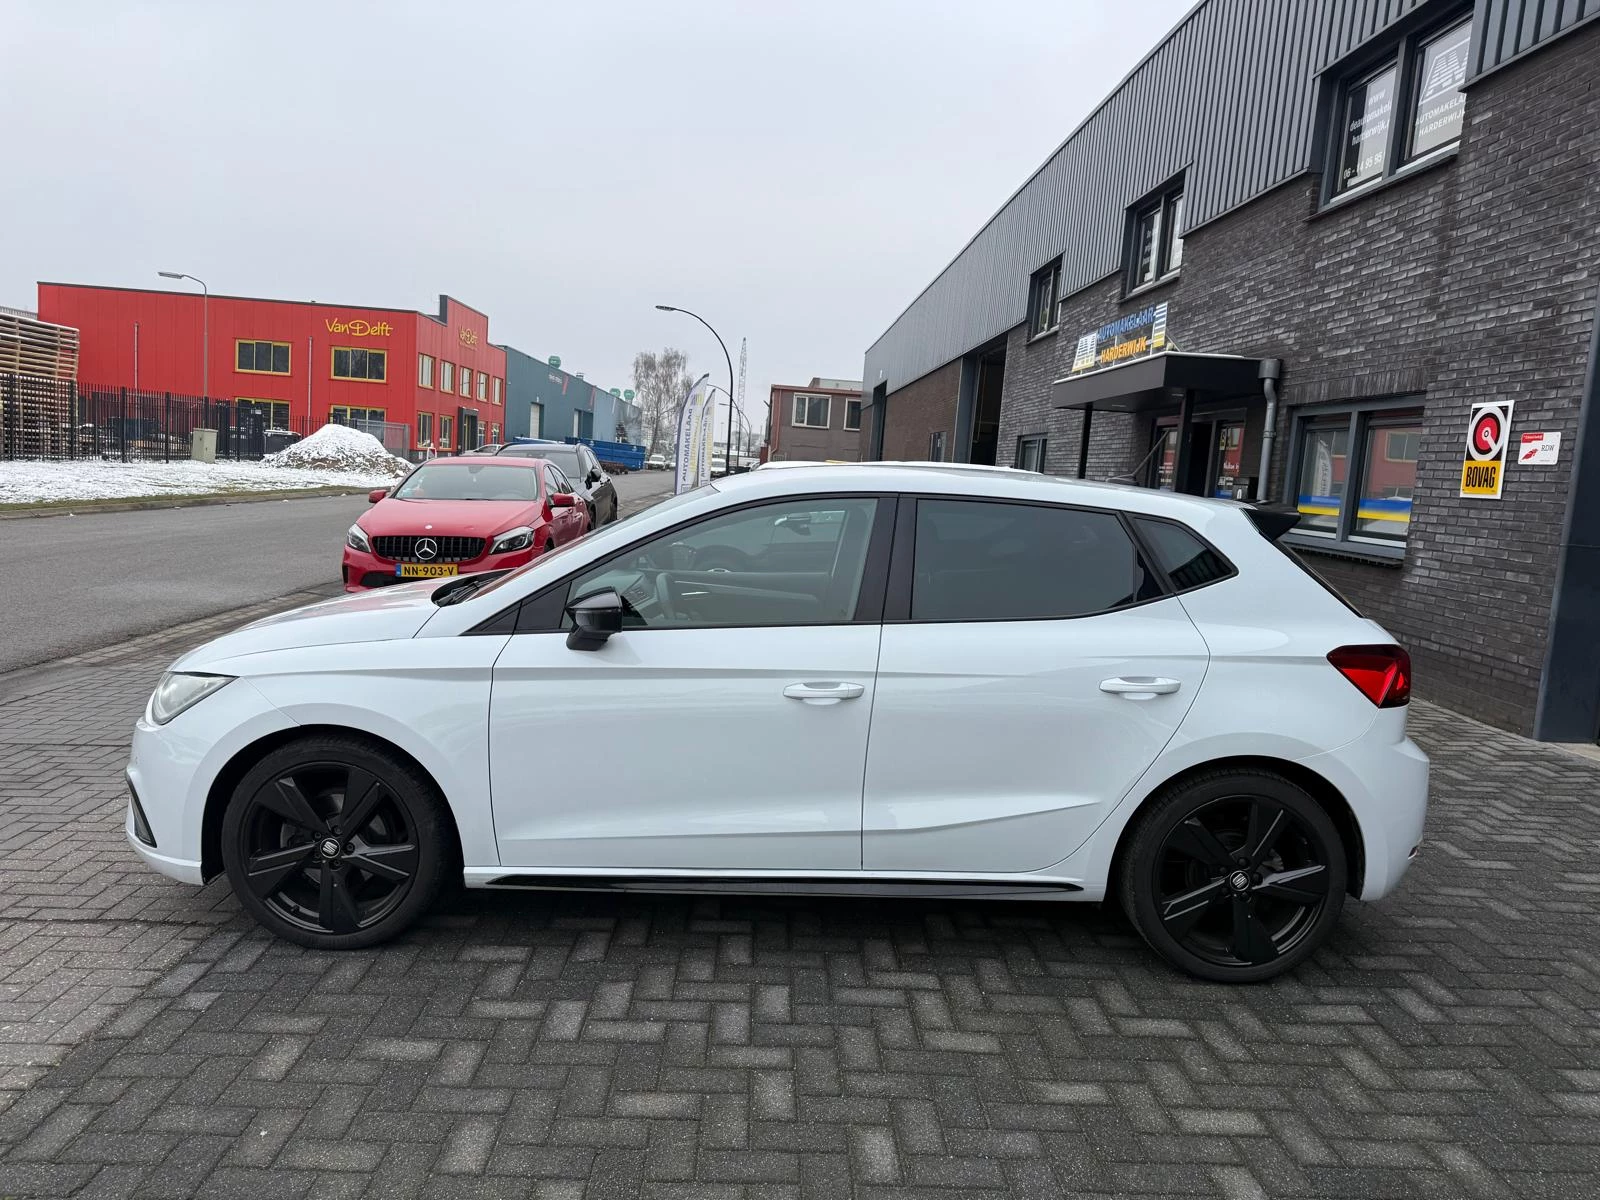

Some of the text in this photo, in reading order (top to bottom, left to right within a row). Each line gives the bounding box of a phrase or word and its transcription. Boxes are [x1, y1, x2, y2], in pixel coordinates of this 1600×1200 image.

[1415, 94, 1467, 125] AUTOMAKELA
[1097, 304, 1155, 344] AUTOMAKELAAR
[1101, 336, 1147, 363] HARDERWIJK
[1465, 466, 1496, 488] BOVAG
[404, 566, 454, 576] NN-903-V
